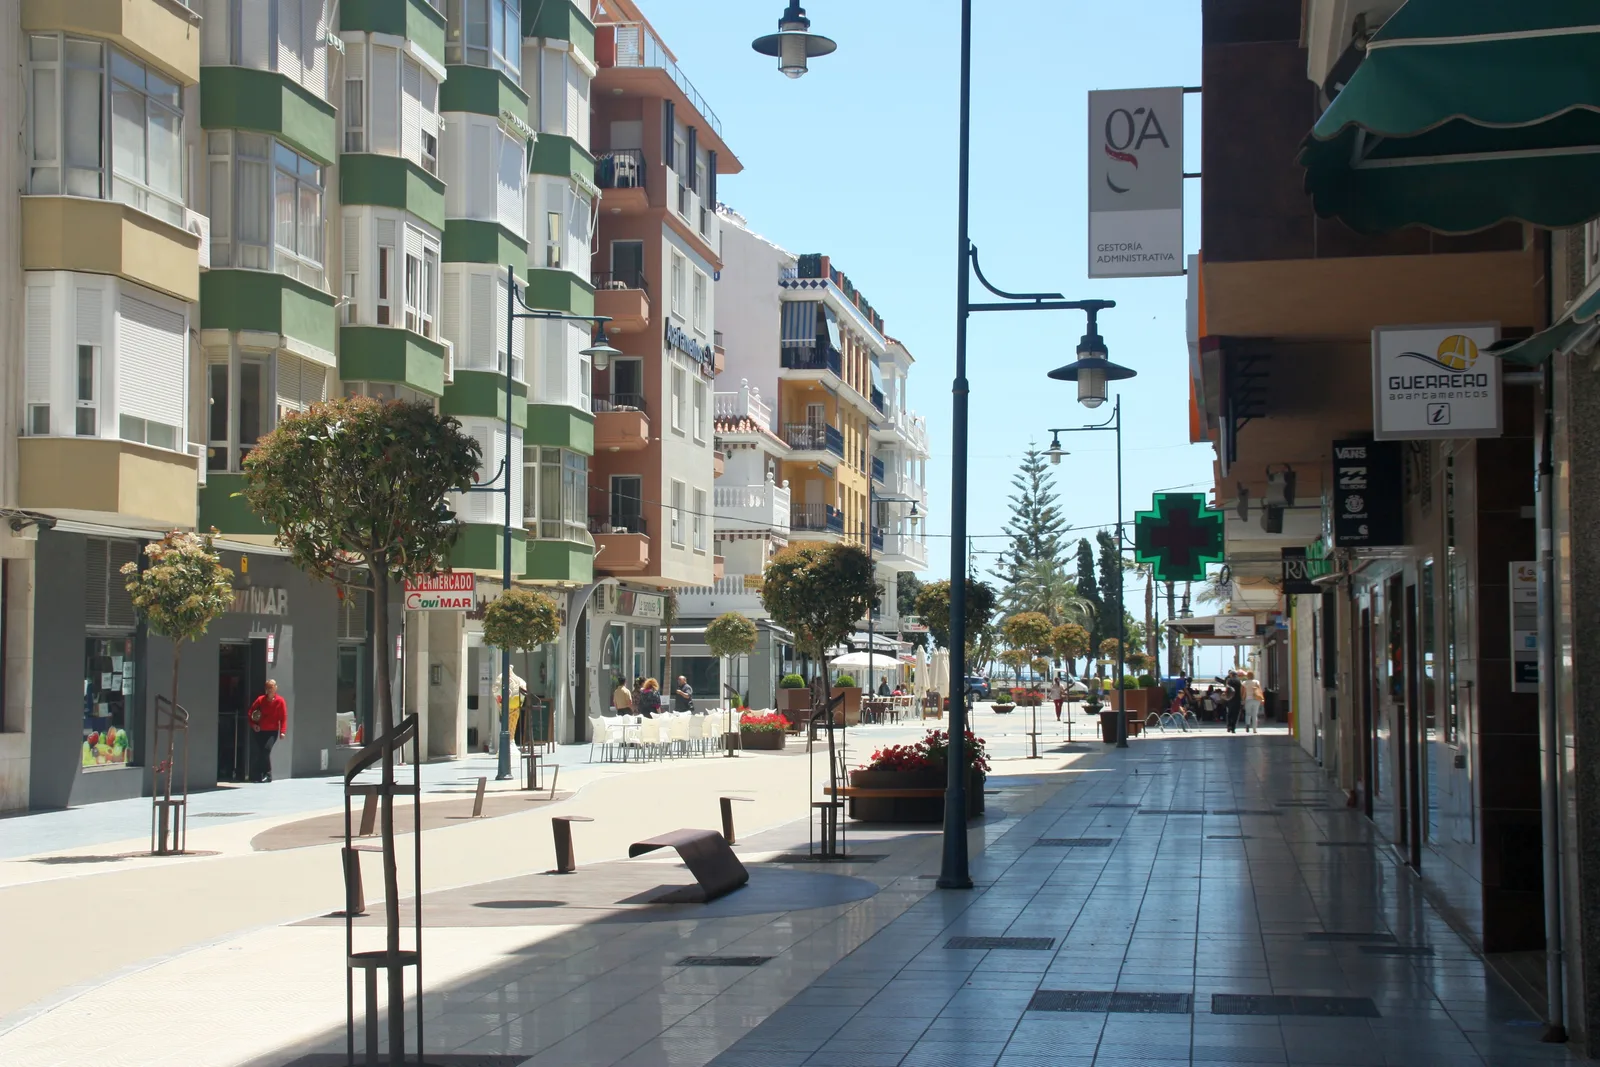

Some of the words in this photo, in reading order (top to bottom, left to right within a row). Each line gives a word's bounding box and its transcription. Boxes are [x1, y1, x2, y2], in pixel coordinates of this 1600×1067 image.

[1097, 241, 1143, 252] GESTORÍA
[1097, 252, 1175, 263] ADMINISTRATIVA
[1389, 374, 1488, 390] GUERRERO
[1389, 390, 1489, 401] apartamentos
[1335, 447, 1367, 459] VANS
